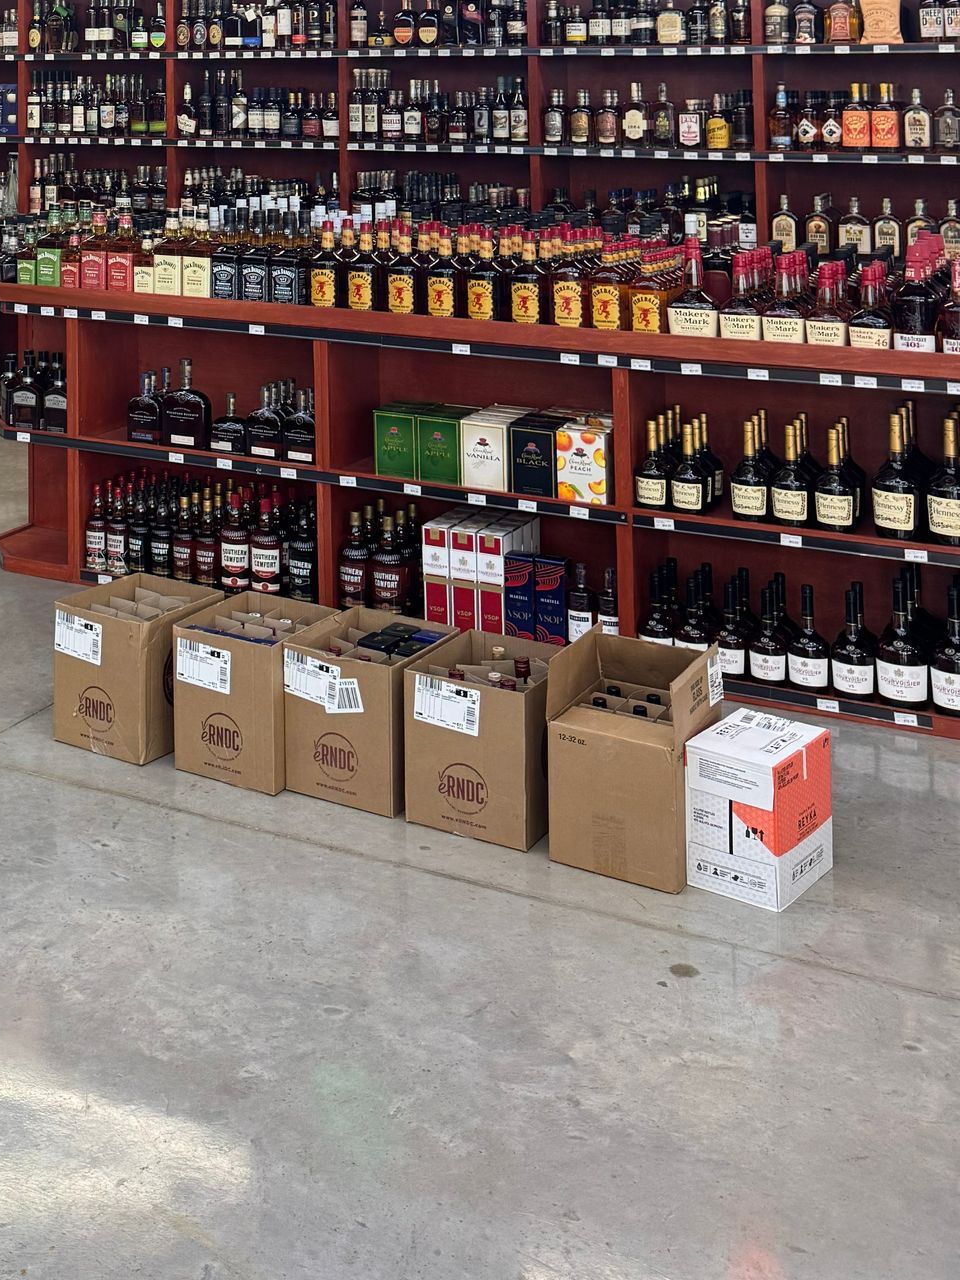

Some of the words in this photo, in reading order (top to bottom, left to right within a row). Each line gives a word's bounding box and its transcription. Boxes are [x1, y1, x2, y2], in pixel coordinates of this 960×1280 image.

[921, 8, 941, 17] SHEEP
[312, 271, 333, 281] FIREBALL
[349, 273, 370, 283] FIREBALL
[389, 275, 412, 286] FIREBALL
[429, 277, 452, 288] FIREBALL
[468, 280, 490, 291] FIREBALL
[513, 285, 537, 295] FIREBALL
[555, 284, 580, 295] FIREBALL
[592, 287, 619, 298] FIREBALL
[632, 296, 659, 307] FIREBALL
[674, 310, 710, 318] Maker's
[766, 318, 799, 326] Maker's
[809, 324, 840, 332] Maker's
[874, 338, 888, 347] 46
[381, 445, 408, 453] APPLE
[466, 452, 500, 462] VANILLA
[516, 458, 549, 467] BLACK
[776, 498, 800, 506] Hennessy
[820, 502, 847, 512] Hennessy
[874, 500, 904, 513] Hennessy
[222, 548, 247, 556] SOUTHERN
[254, 560, 276, 568] COMFORT
[373, 571, 400, 582] SOUTHERN
[374, 578, 398, 588] COMFORT
[429, 605, 445, 613] VSOP
[508, 608, 532, 620] VSOP
[538, 613, 563, 625] VSOP
[880, 676, 921, 688] COURVOISIER
[78, 696, 113, 724] eRNDC
[200, 724, 240, 752] eRNDC
[558, 733, 577, 744] 12-32
[313, 743, 355, 772] eRNDC
[438, 774, 484, 805] eRNDC
[797, 811, 817, 829] REYKA
